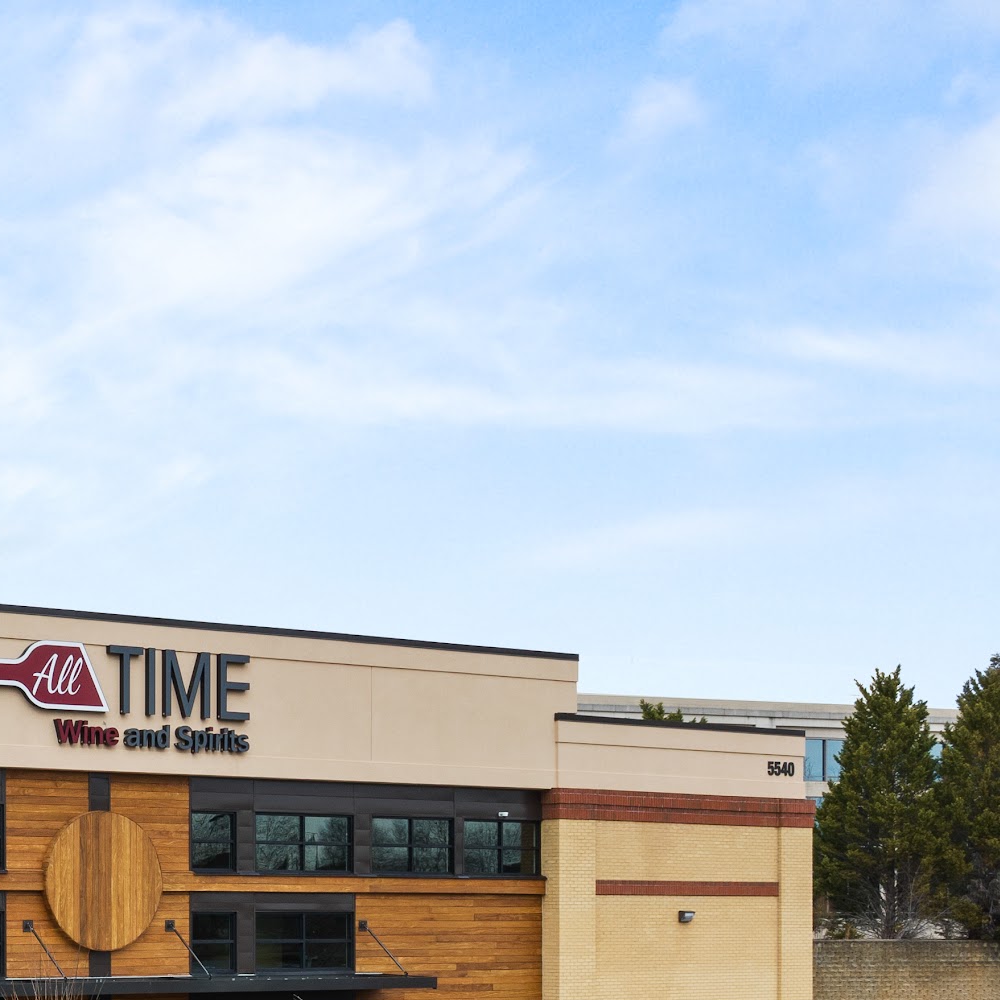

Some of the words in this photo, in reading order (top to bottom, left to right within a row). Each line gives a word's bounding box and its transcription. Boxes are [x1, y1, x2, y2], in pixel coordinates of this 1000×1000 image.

[32, 653, 83, 696] All
[106, 645, 250, 721] TIME
[54, 718, 119, 746] Wine
[123, 725, 170, 749] and
[173, 725, 250, 754] Spirits
[767, 761, 795, 777] 5540
